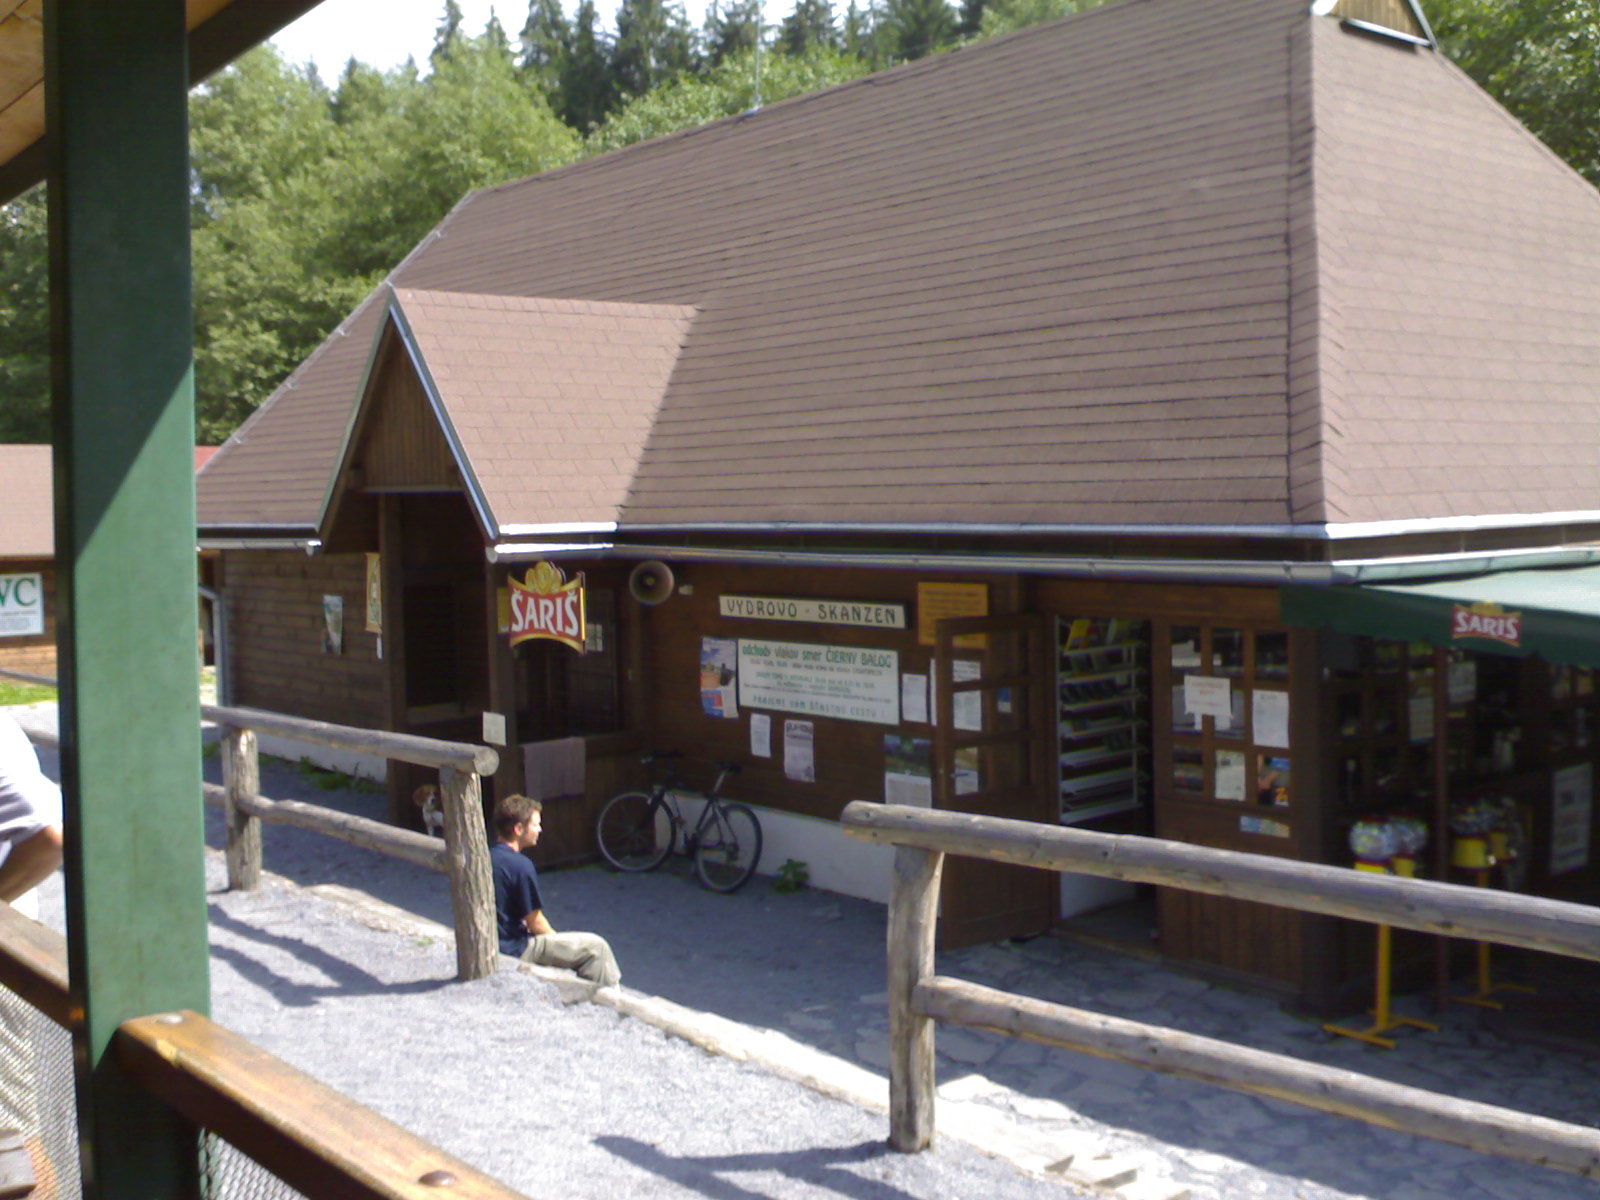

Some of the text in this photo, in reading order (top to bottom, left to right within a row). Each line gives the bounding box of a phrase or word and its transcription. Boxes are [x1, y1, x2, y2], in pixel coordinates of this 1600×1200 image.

[511, 587, 579, 637] ŠARIŠ
[726, 598, 798, 618] VYDROVO
[817, 603, 896, 625] SKANZEN
